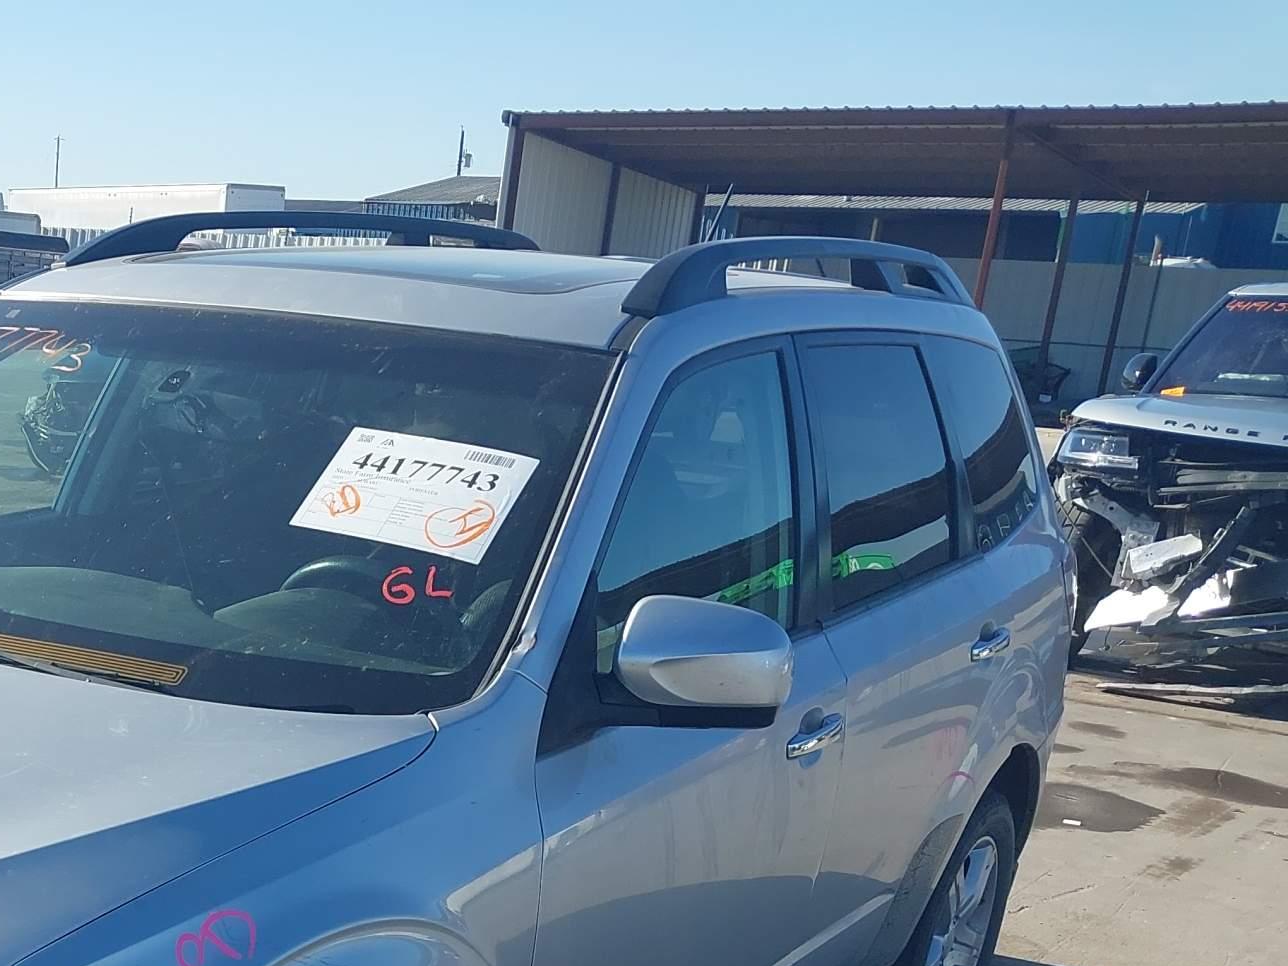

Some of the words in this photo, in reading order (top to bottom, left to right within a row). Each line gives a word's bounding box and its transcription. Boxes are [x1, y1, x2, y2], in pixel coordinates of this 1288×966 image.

[1225, 299, 1288, 312] 441915
[1164, 419, 1261, 437] RANGE
[352, 452, 500, 492] 44177743
